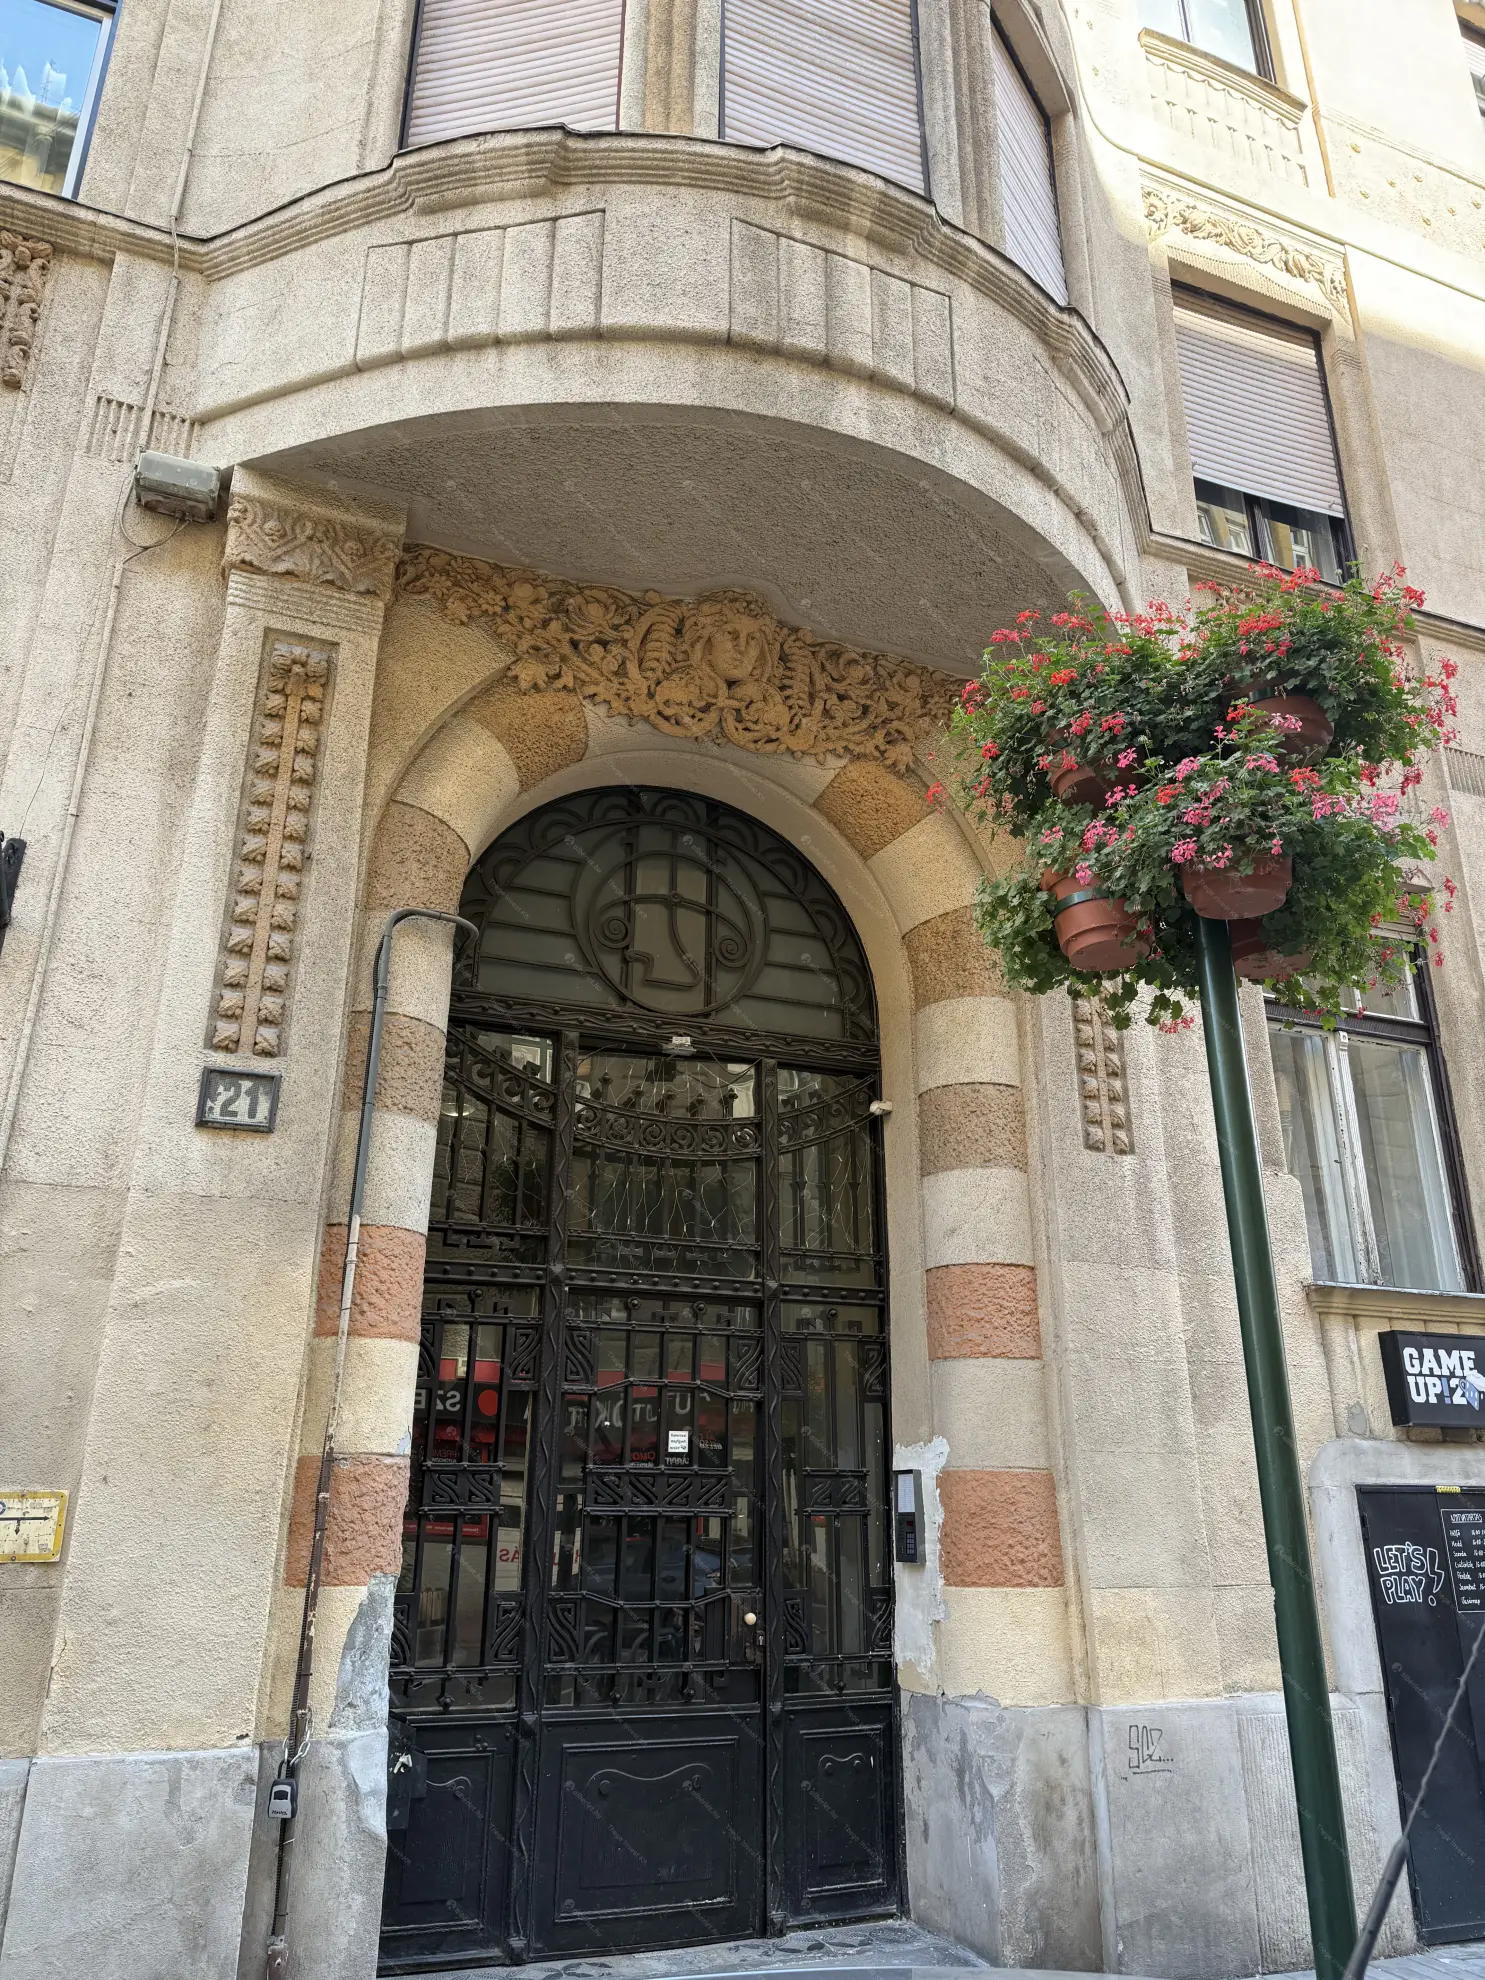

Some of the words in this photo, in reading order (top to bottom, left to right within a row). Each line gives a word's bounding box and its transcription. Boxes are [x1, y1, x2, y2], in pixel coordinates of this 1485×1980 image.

[219, 1080, 262, 1119] 21
[1402, 1347, 1478, 1376] GAME
[1374, 1541, 1427, 1574] LET'S
